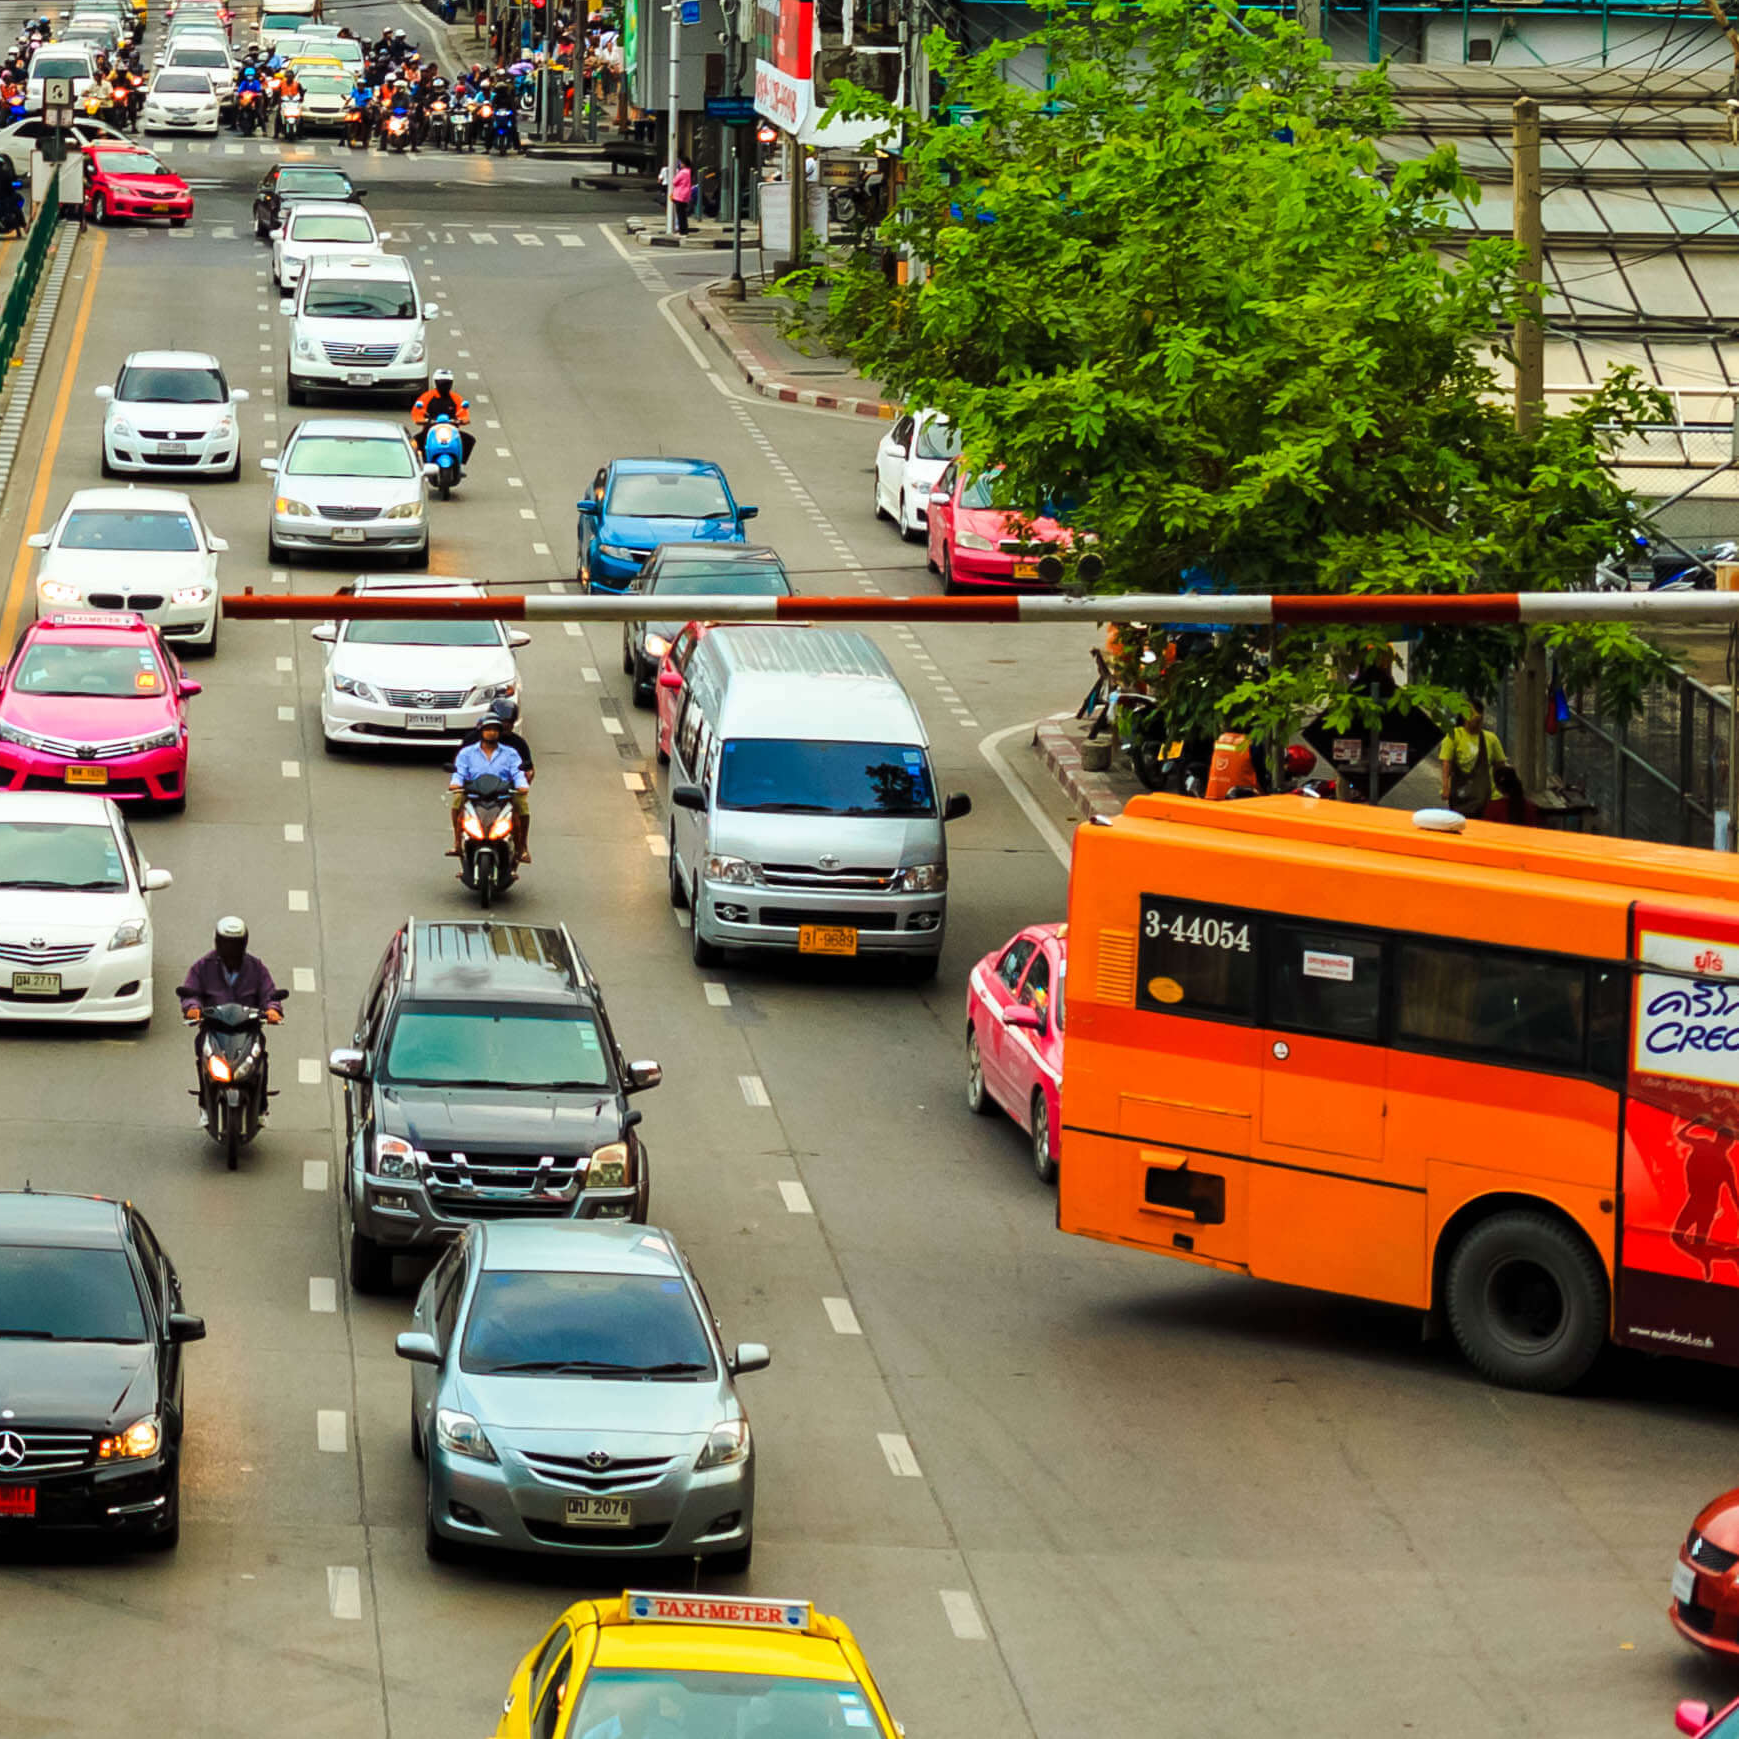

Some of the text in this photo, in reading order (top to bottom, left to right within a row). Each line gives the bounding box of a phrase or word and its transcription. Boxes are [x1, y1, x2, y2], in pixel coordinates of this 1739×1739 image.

[1144, 909, 1252, 953] 3-44054
[593, 1500, 627, 1515] 2078
[655, 1600, 784, 1623] TAXI-METER
